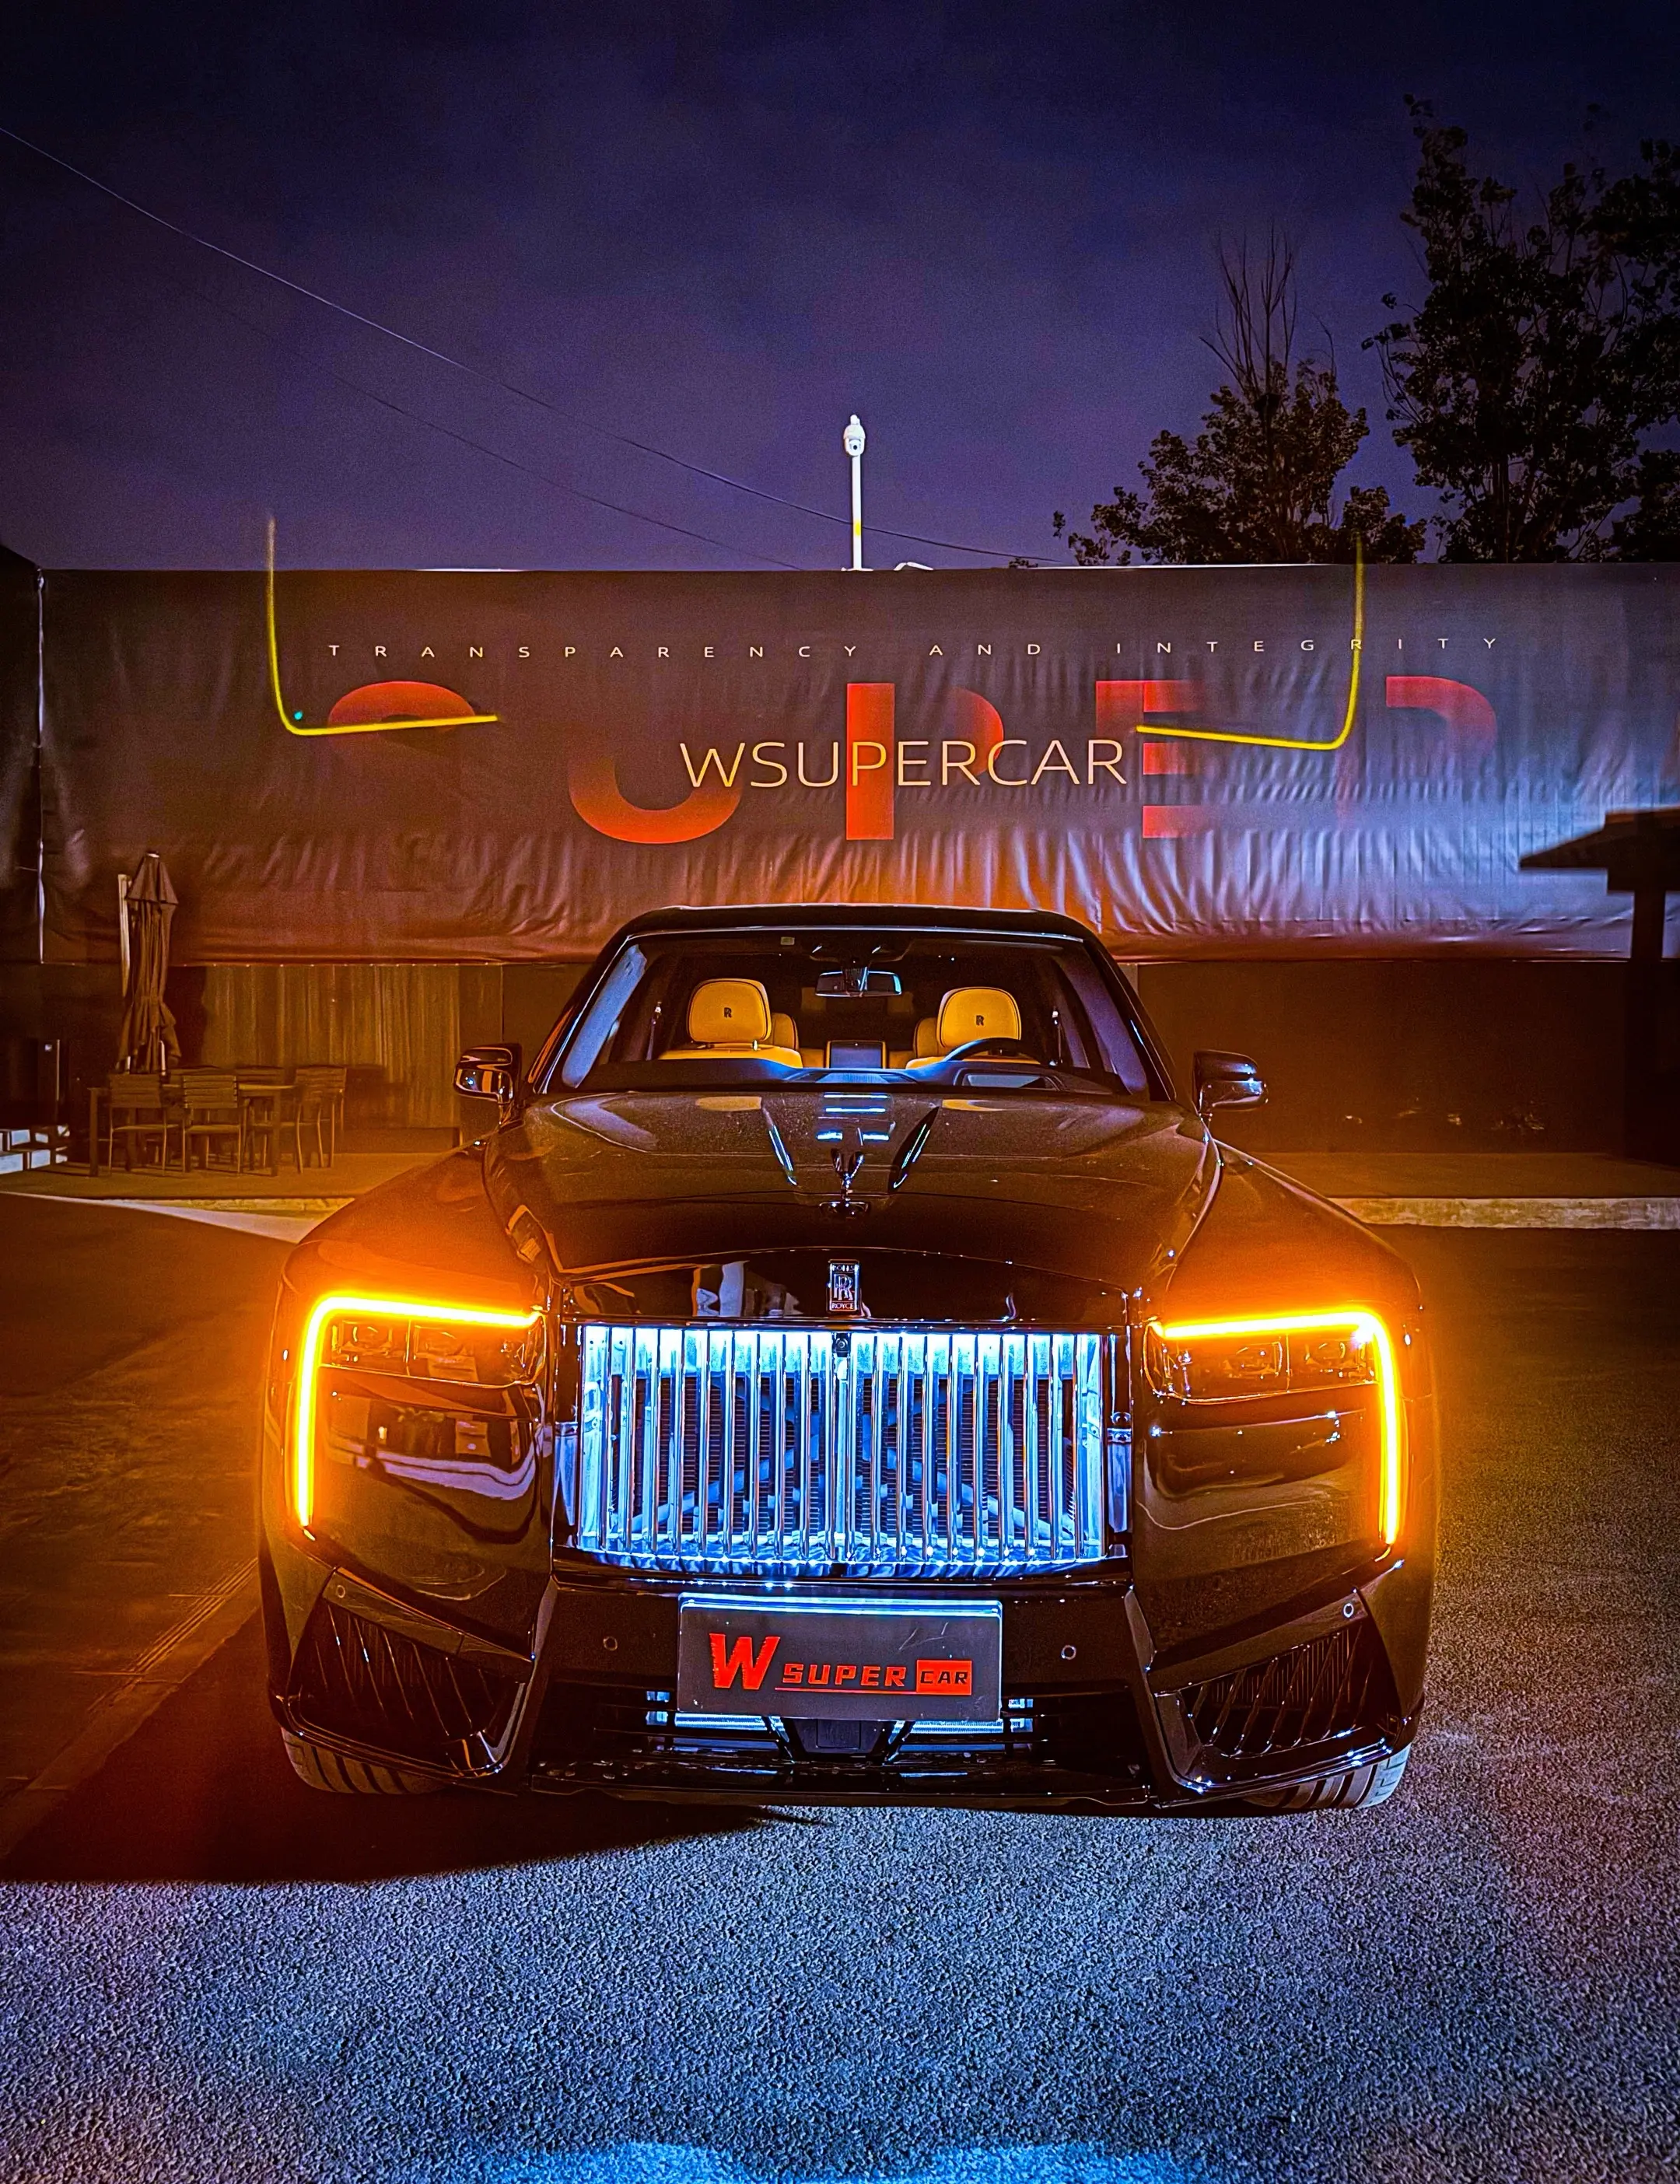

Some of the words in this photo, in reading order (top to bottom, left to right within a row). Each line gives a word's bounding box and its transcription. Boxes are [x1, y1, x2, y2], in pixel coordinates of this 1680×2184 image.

[329, 643, 857, 659] TRANSPARENCY
[928, 641, 1042, 657] AND
[1115, 637, 1497, 655] INTEGRITY
[680, 739, 1126, 789] WSUPERCAR
[831, 1302, 855, 1311] ROYCE
[709, 1633, 781, 1691] W
[782, 1663, 908, 1688] SUPER
[919, 1669, 969, 1686] CAR
